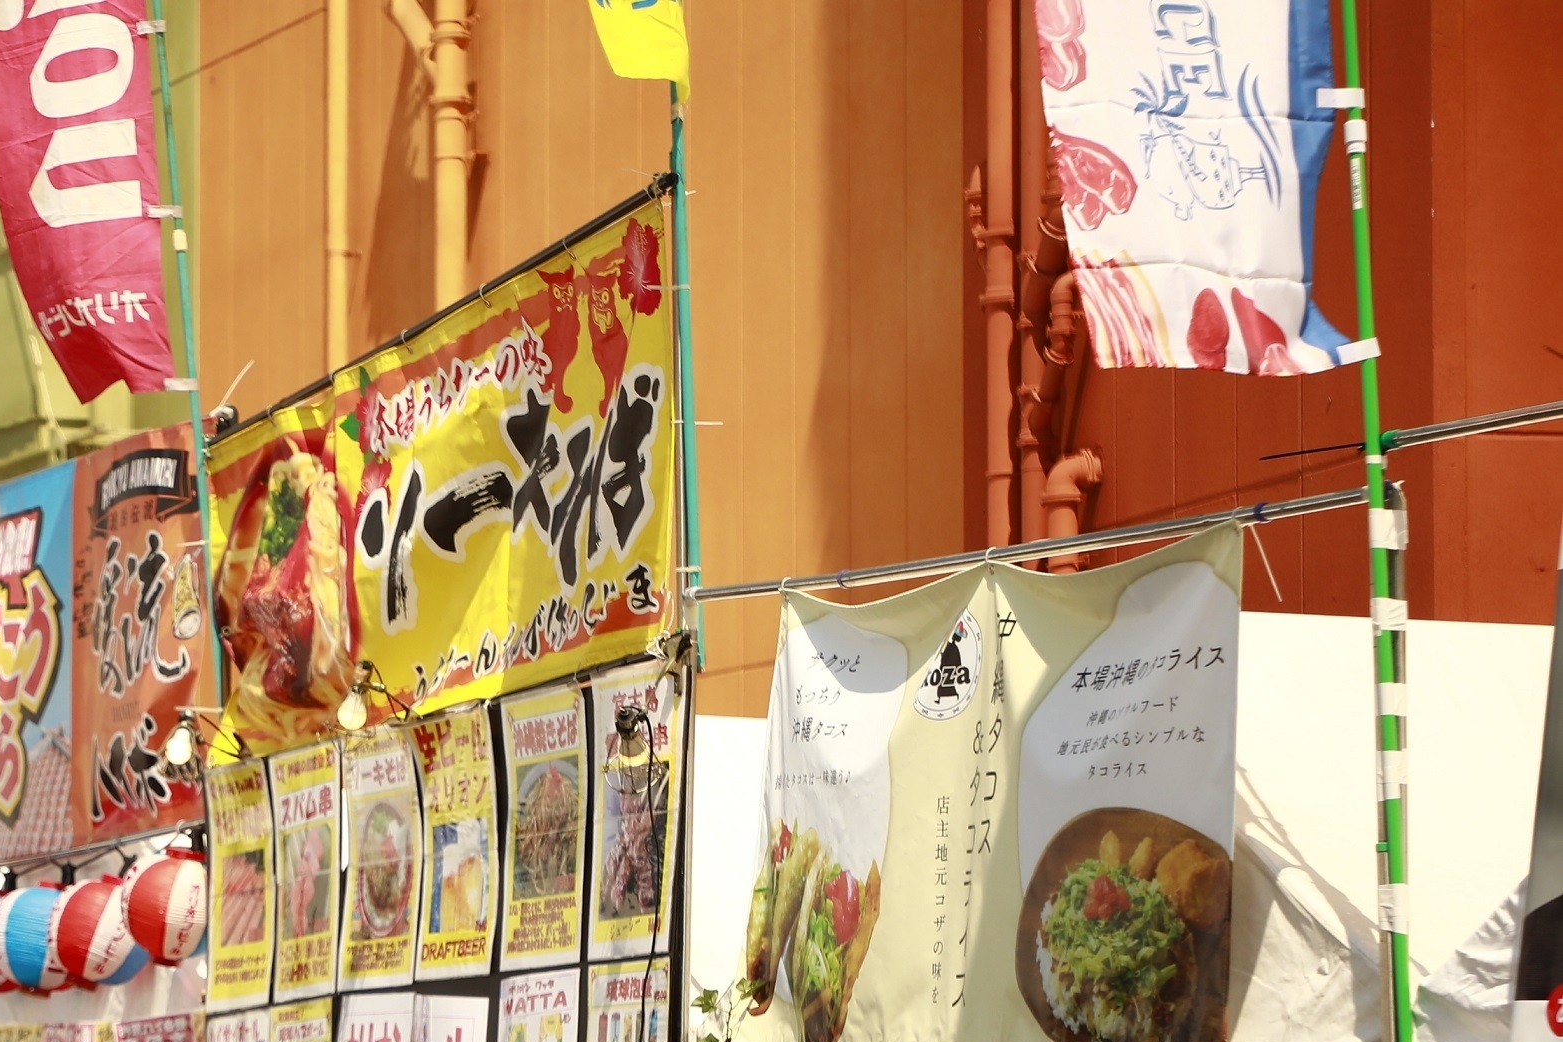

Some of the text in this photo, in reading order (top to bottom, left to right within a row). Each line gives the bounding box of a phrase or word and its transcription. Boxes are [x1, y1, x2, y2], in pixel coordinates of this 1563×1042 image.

[359, 372, 660, 625] ソーキそば
[791, 715, 849, 744] 沖縄タコス
[1056, 726, 1206, 757] 地元民が食べるシンプルな
[1088, 762, 1147, 780] タコライス
[929, 794, 951, 1005] 店主地元コザの味を
[421, 937, 487, 962] DRAFTBEER
